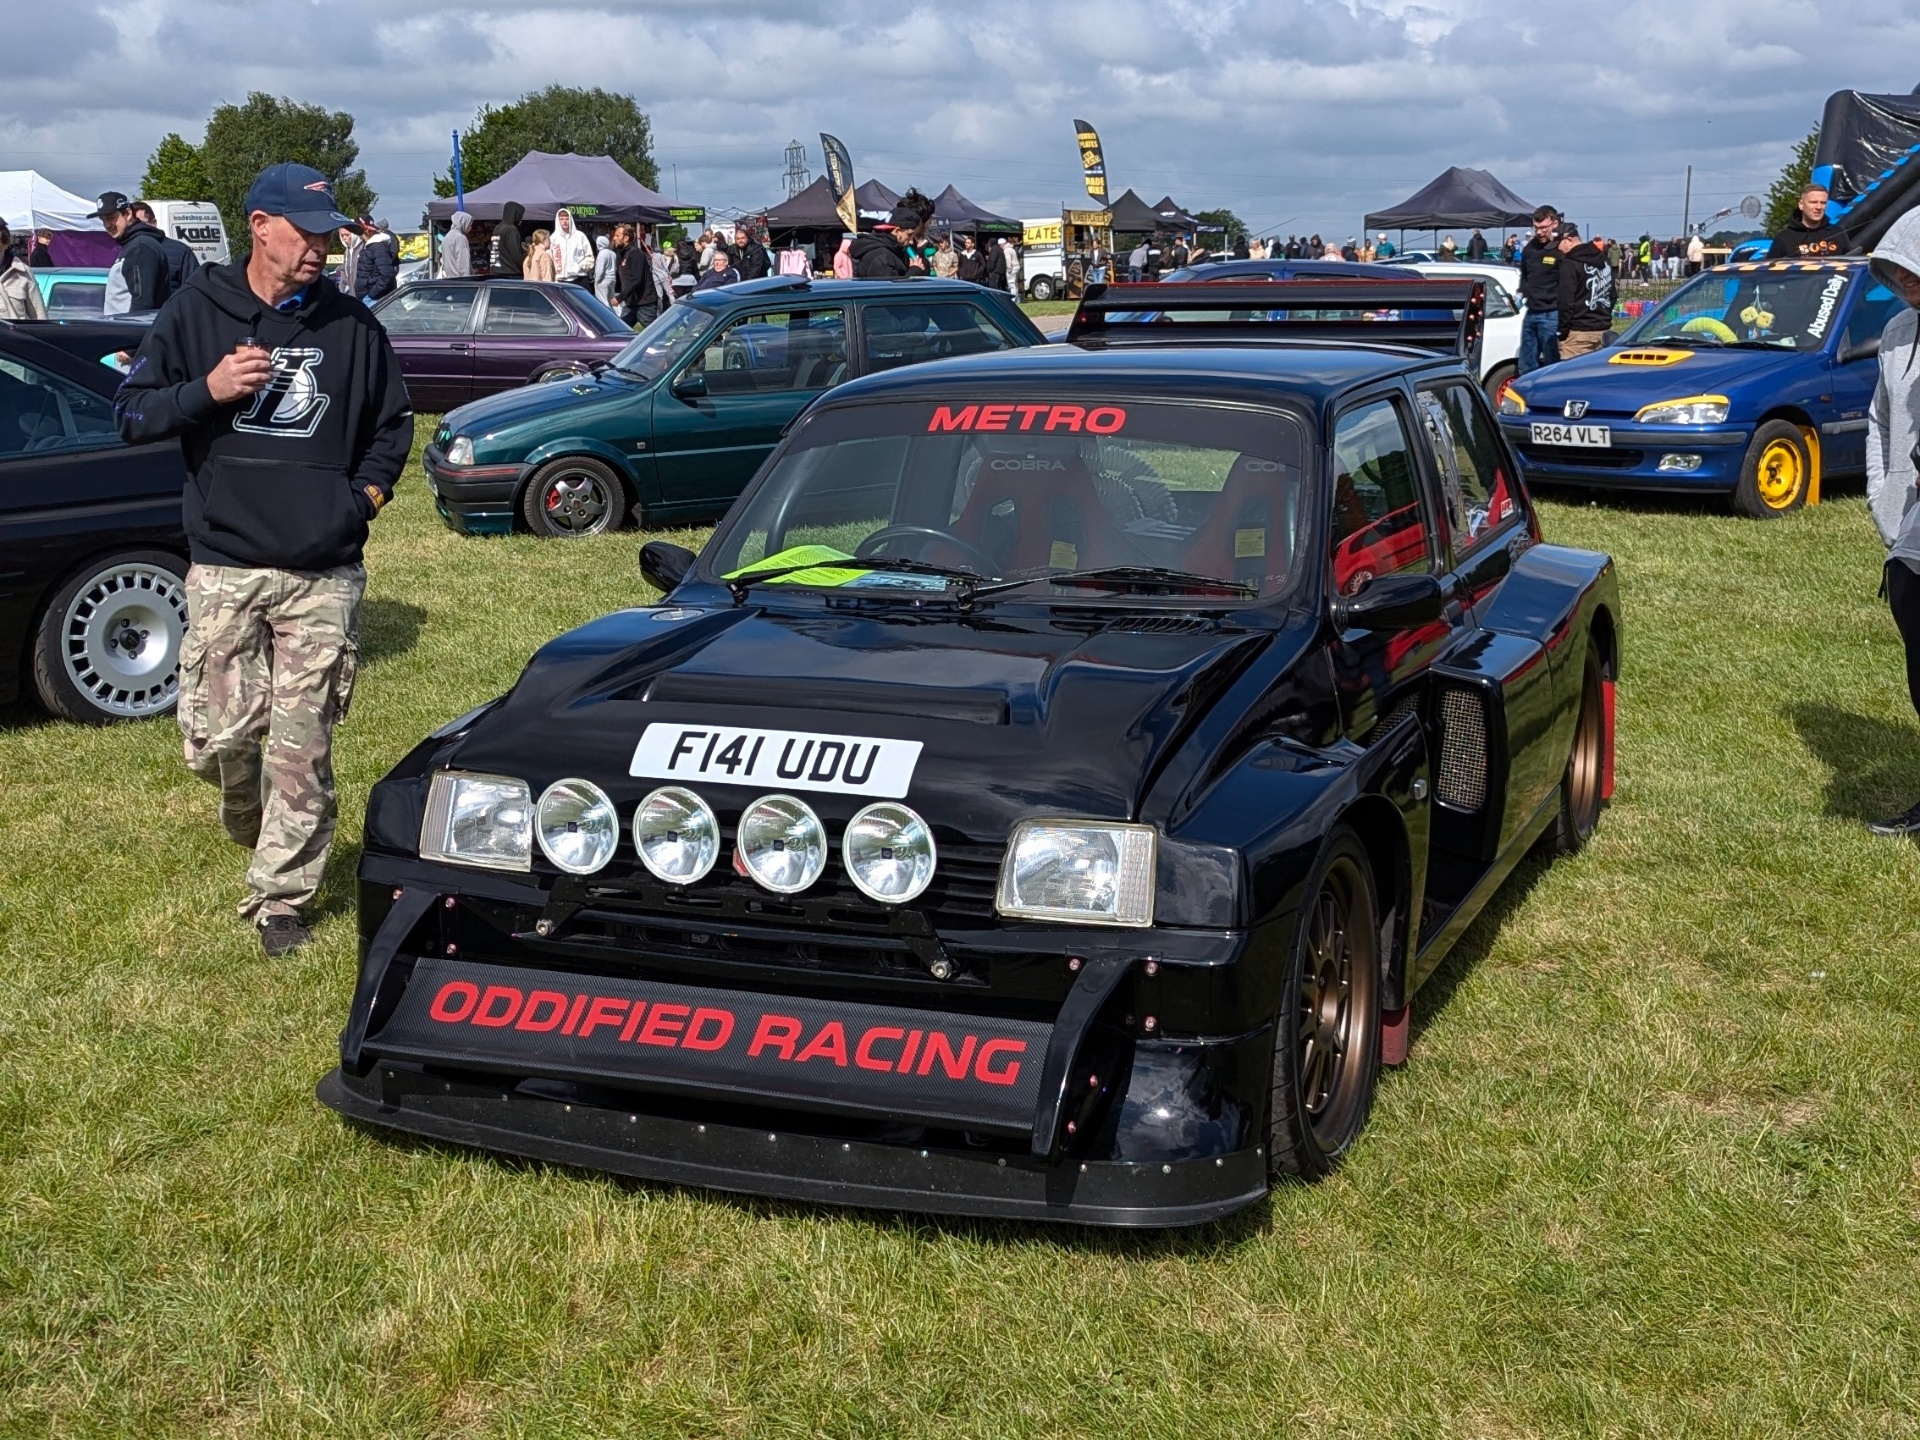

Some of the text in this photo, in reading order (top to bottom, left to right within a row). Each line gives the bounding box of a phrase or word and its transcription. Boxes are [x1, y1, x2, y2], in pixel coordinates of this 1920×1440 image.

[175, 225, 221, 243] kode
[1807, 274, 1849, 339] Abused Daily
[927, 404, 1127, 434] METRO
[1533, 425, 1609, 444] R264 VLT
[990, 459, 1067, 471] COBRA
[667, 731, 881, 785] F141 UDU
[429, 981, 1028, 1085] ODDIFIED RACING
